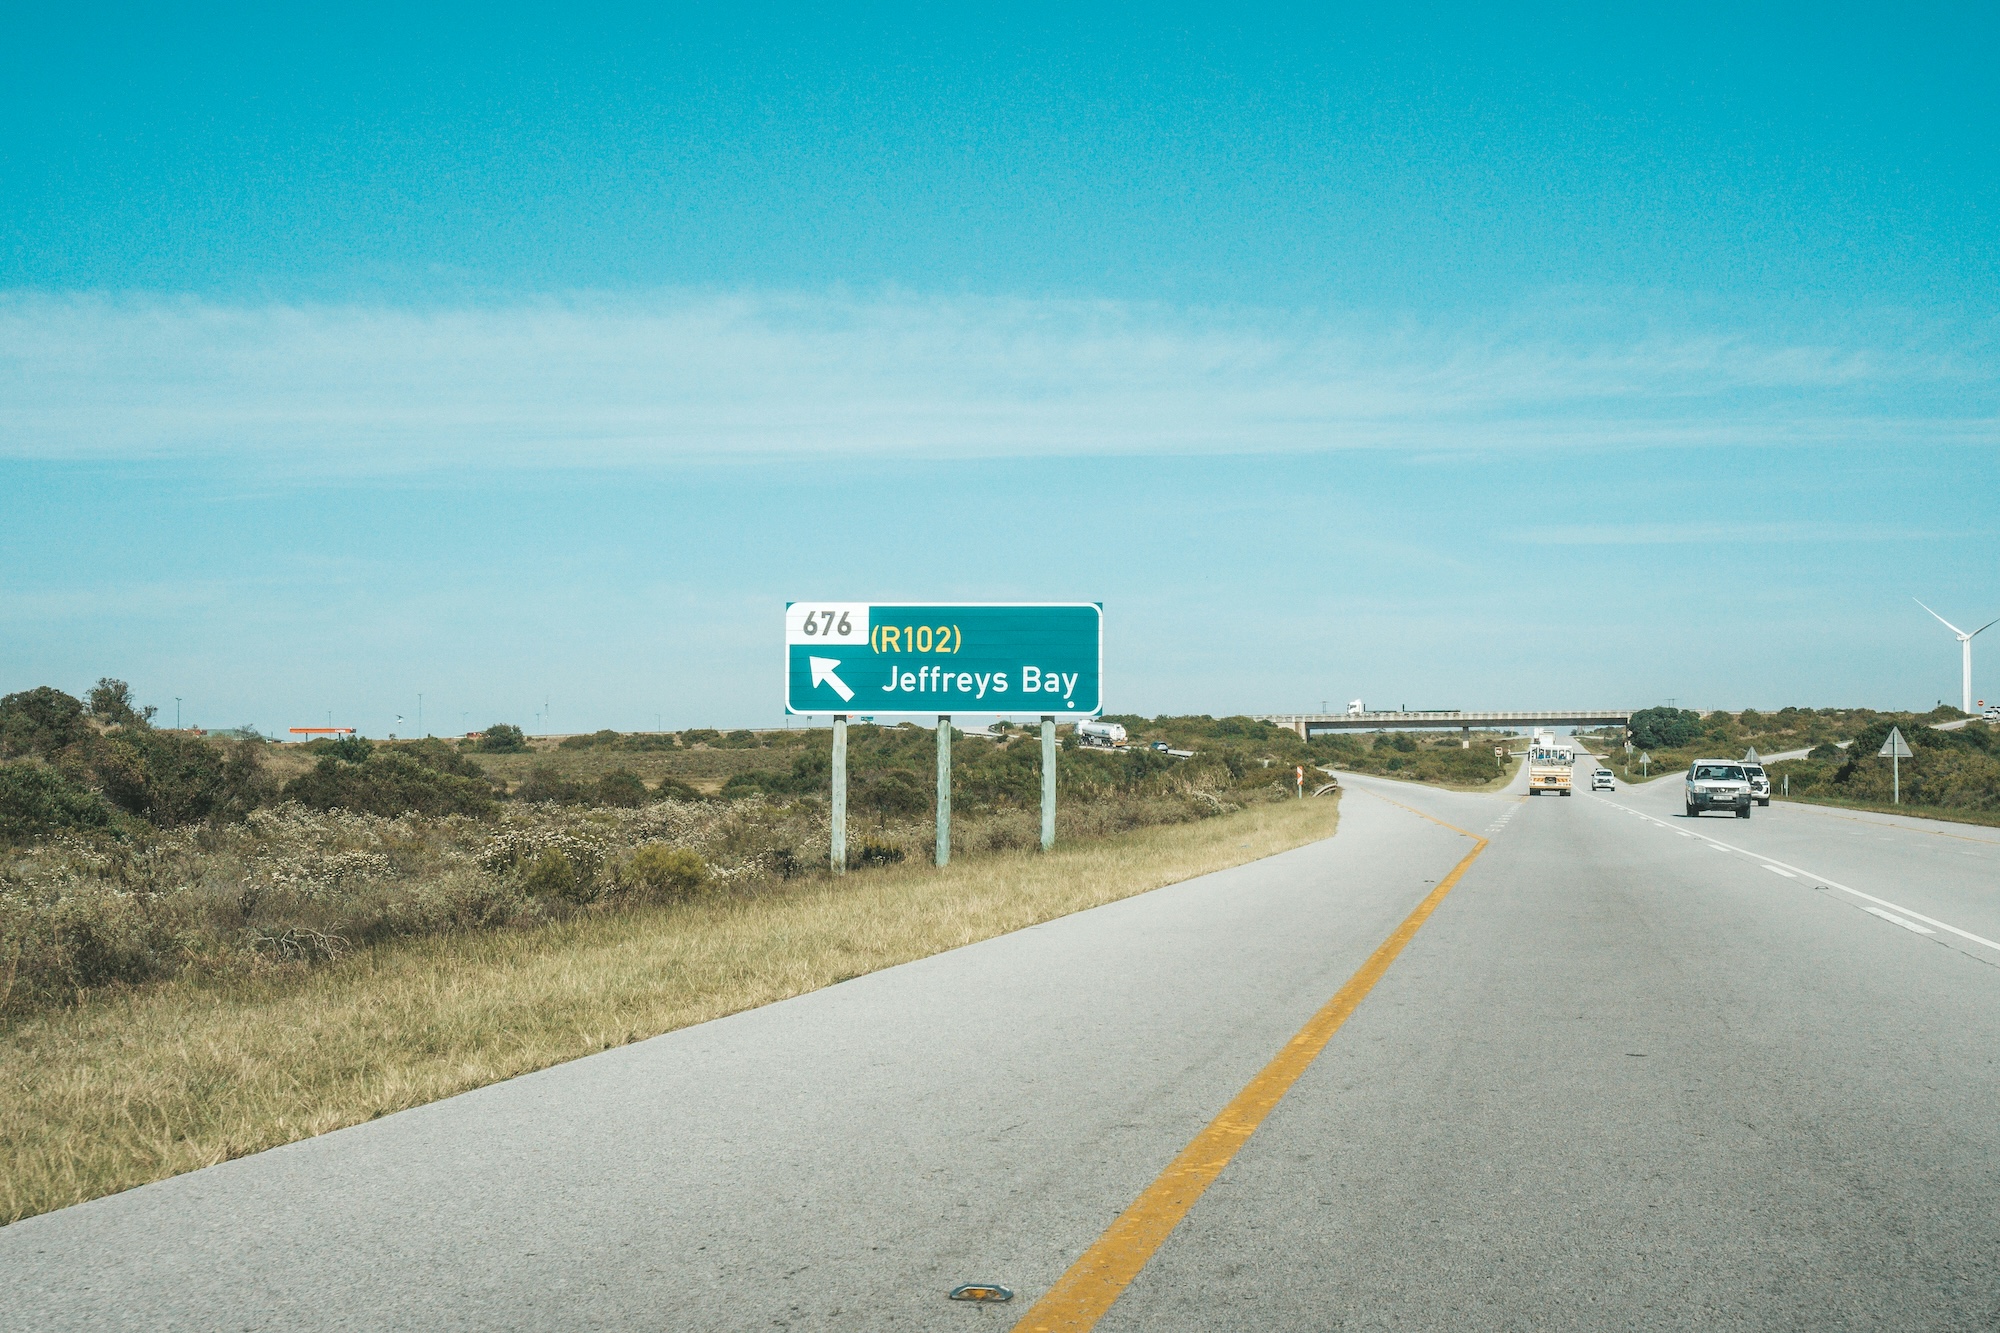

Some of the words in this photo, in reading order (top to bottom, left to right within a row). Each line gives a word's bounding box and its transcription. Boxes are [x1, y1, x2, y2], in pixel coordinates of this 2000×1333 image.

[803, 611, 852, 636] 676
[871, 625, 962, 654] (R102)
[882, 666, 1008, 699] Jeffreys
[1022, 666, 1079, 699] Bay
